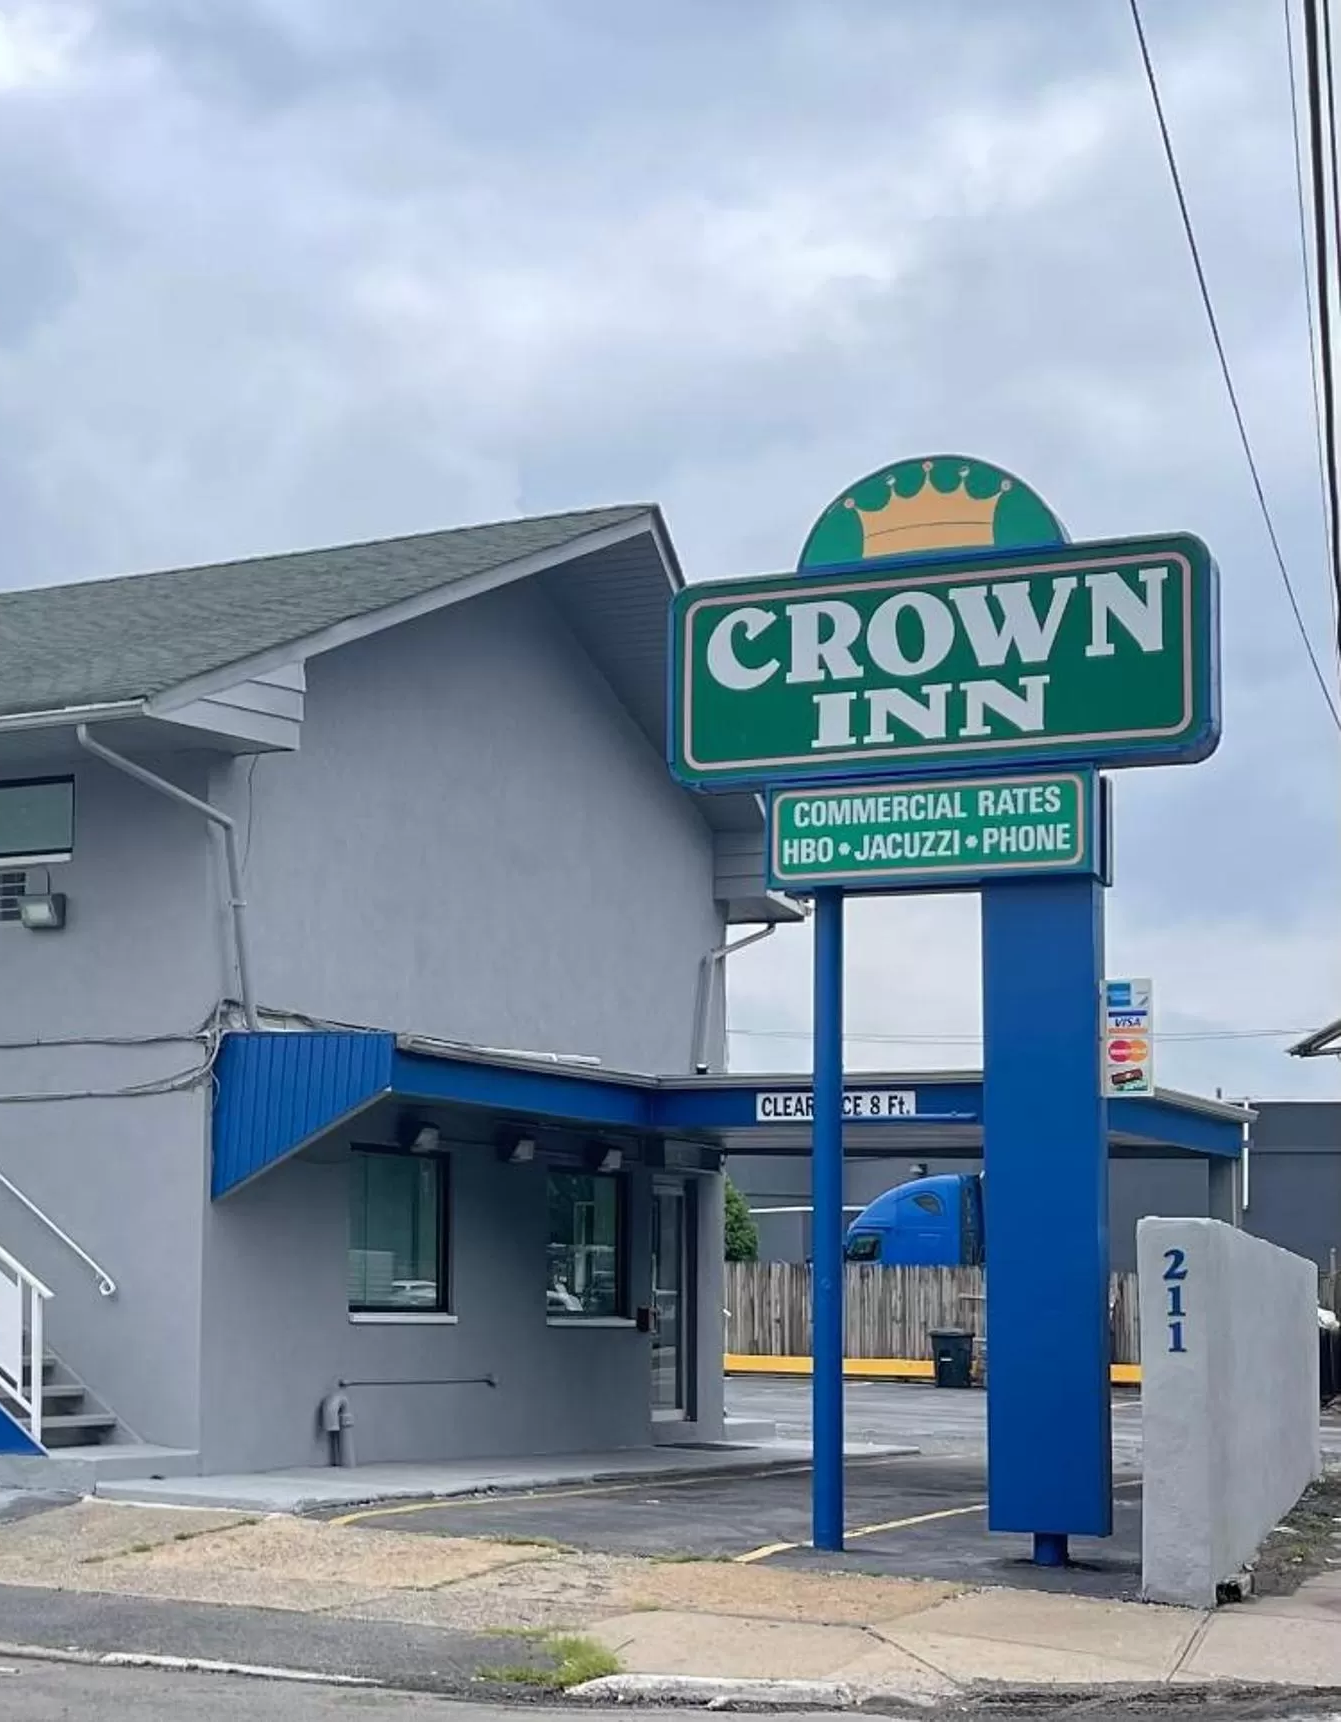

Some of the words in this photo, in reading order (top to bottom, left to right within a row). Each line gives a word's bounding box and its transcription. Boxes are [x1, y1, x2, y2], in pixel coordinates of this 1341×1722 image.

[706, 566, 1169, 691] CROWN
[810, 674, 1051, 749] INN
[793, 791, 968, 828] COMMERCIAL
[977, 785, 1062, 817] RATES
[782, 836, 834, 865] HBO
[854, 829, 961, 861] JACUZZI
[982, 823, 1071, 854] PHONE
[1114, 1017, 1142, 1028] VISA
[761, 1095, 863, 1117] CLEARCE
[869, 1095, 881, 1115] 8
[887, 1095, 911, 1116] Ft.
[1162, 1248, 1189, 1353] 211
